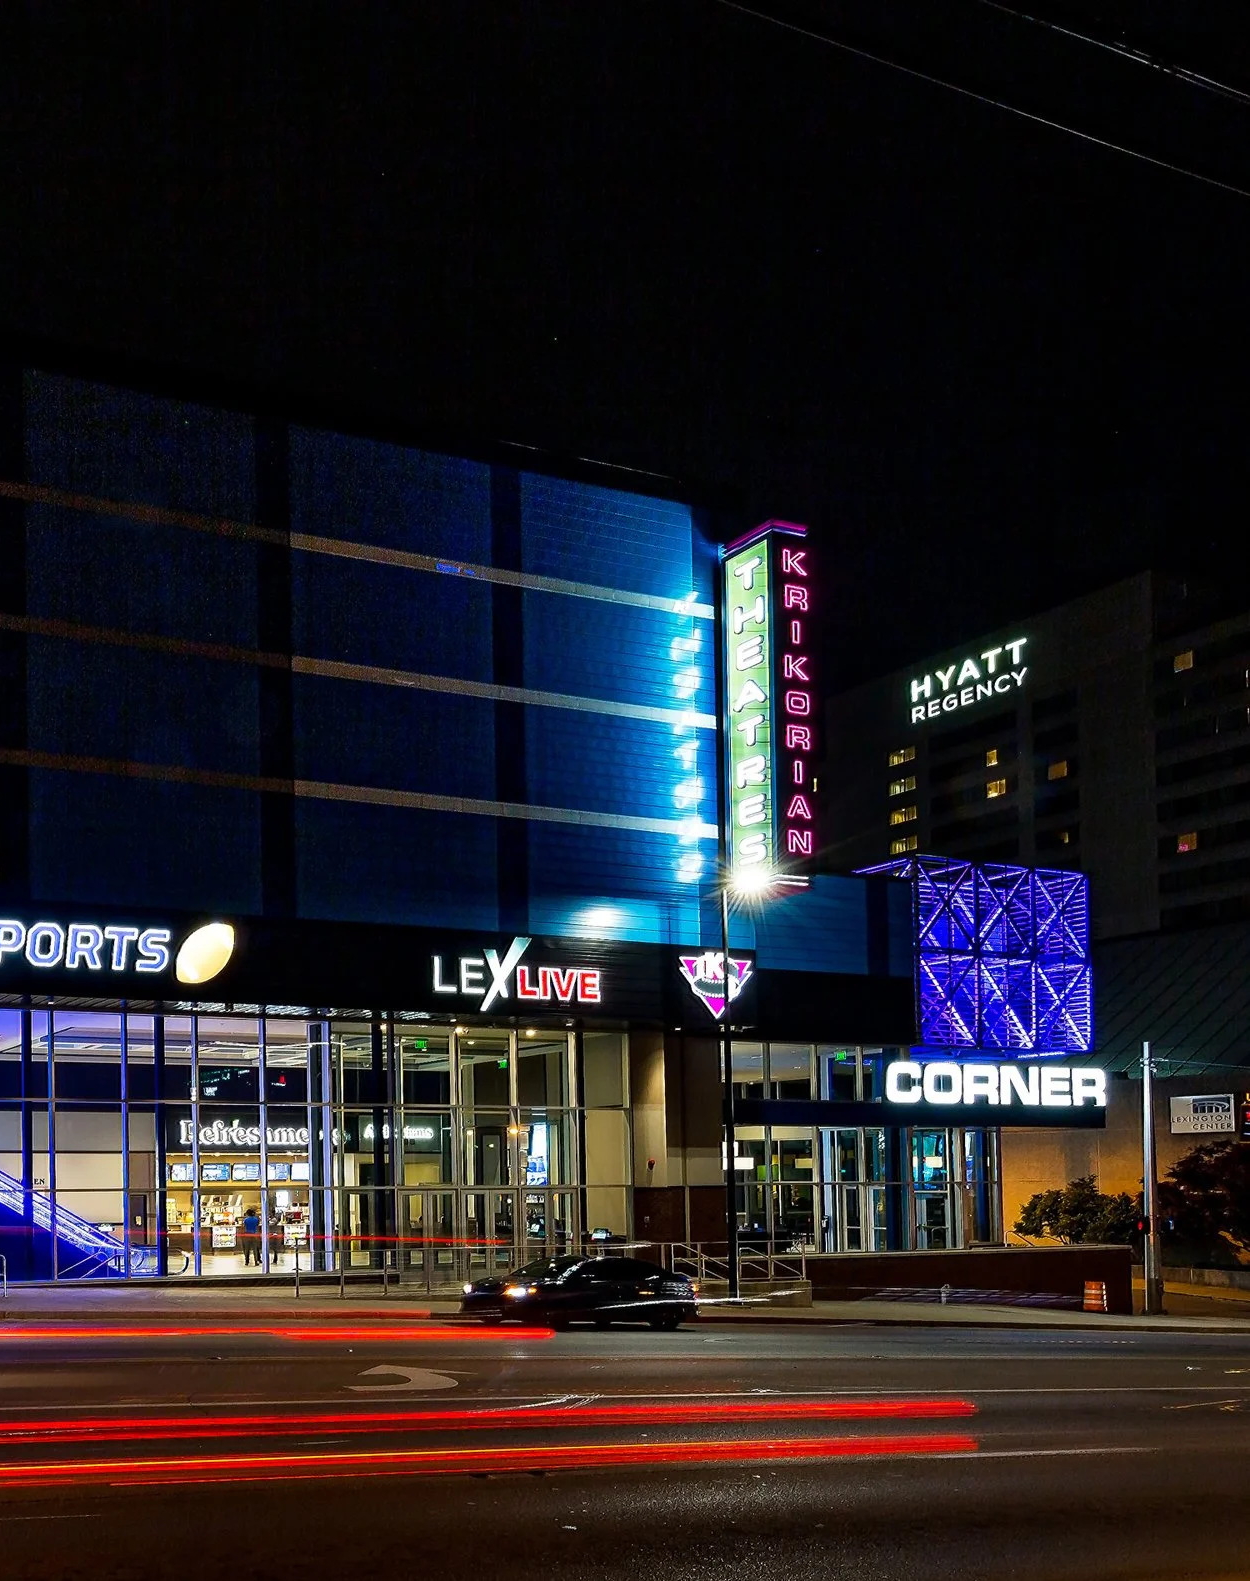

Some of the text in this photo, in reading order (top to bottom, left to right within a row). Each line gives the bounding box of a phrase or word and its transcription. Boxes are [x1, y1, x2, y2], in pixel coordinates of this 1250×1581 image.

[910, 637, 1028, 703] HYATT
[911, 667, 1028, 724] REGENCY
[733, 555, 768, 870] THEATRES
[782, 549, 812, 855] KRIKORIAN
[516, 966, 601, 1003] LIVE
[885, 1060, 1107, 1107] CORNER
[1171, 1114, 1231, 1123] LEXINGTON
[1192, 1122, 1233, 1131] CENTER
